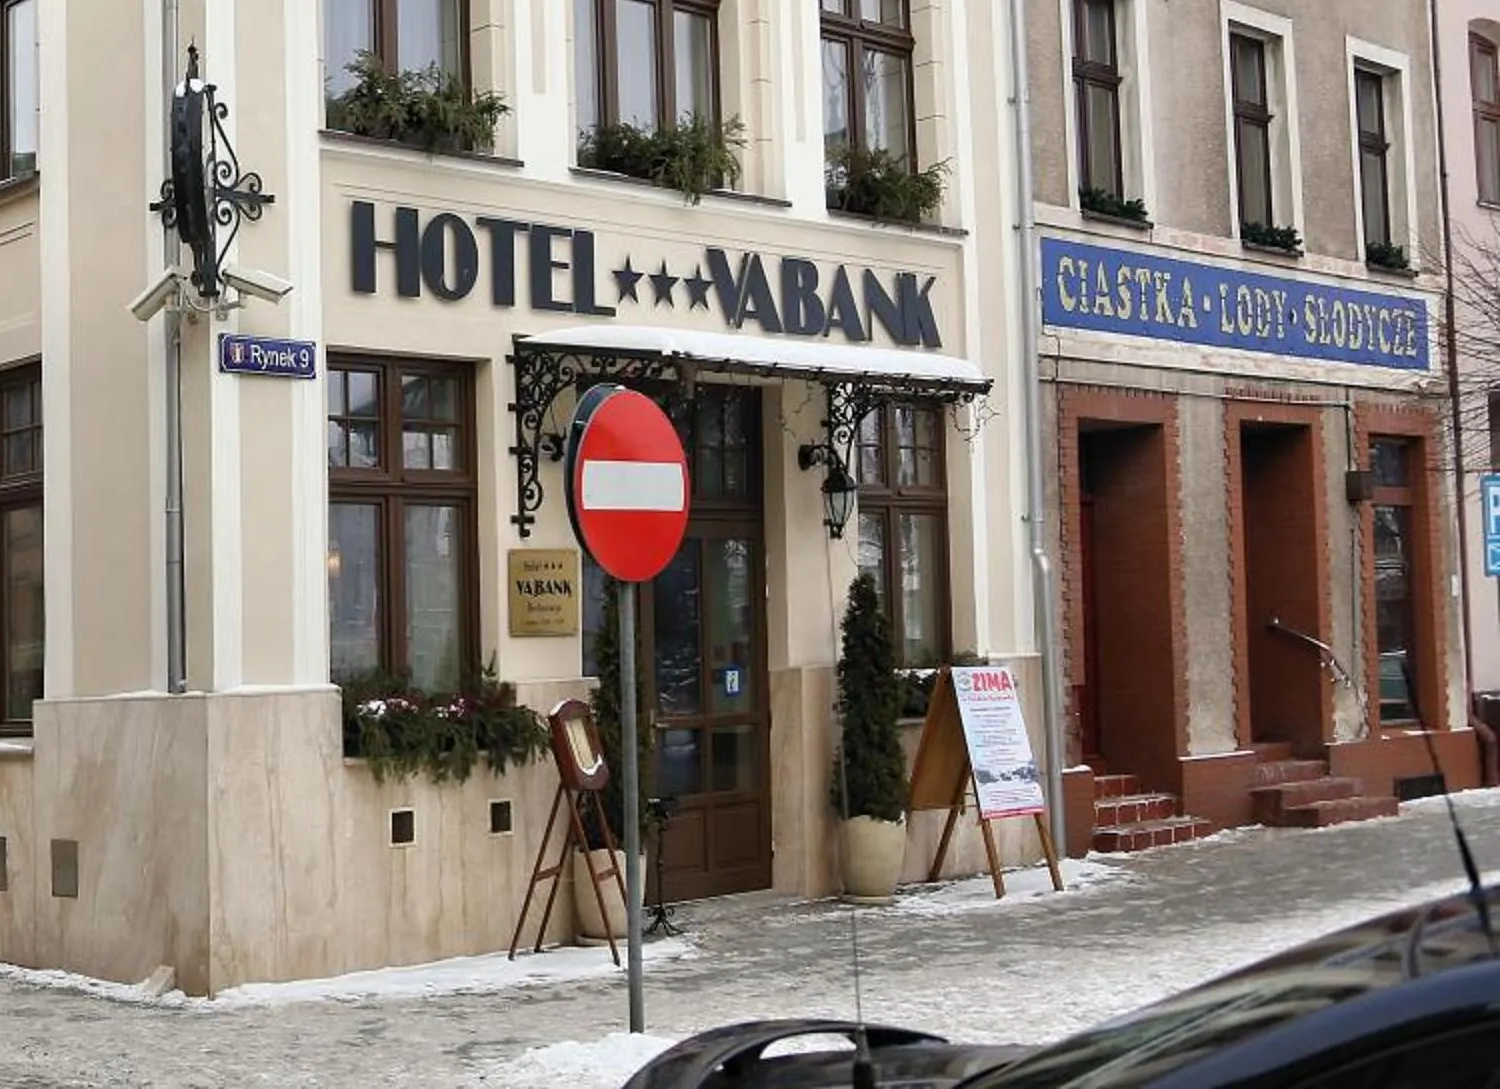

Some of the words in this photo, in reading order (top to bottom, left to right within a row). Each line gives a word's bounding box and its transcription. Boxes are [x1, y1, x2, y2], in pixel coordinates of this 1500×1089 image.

[352, 200, 616, 317] HOTEL
[706, 248, 942, 348] VABANK
[1058, 256, 1198, 328] CIASTKA
[1219, 283, 1287, 339] LODY
[250, 344, 297, 369] Rynek
[300, 349, 309, 368] 9
[516, 579, 572, 597] VABANK
[972, 671, 1013, 691] ZIMA
